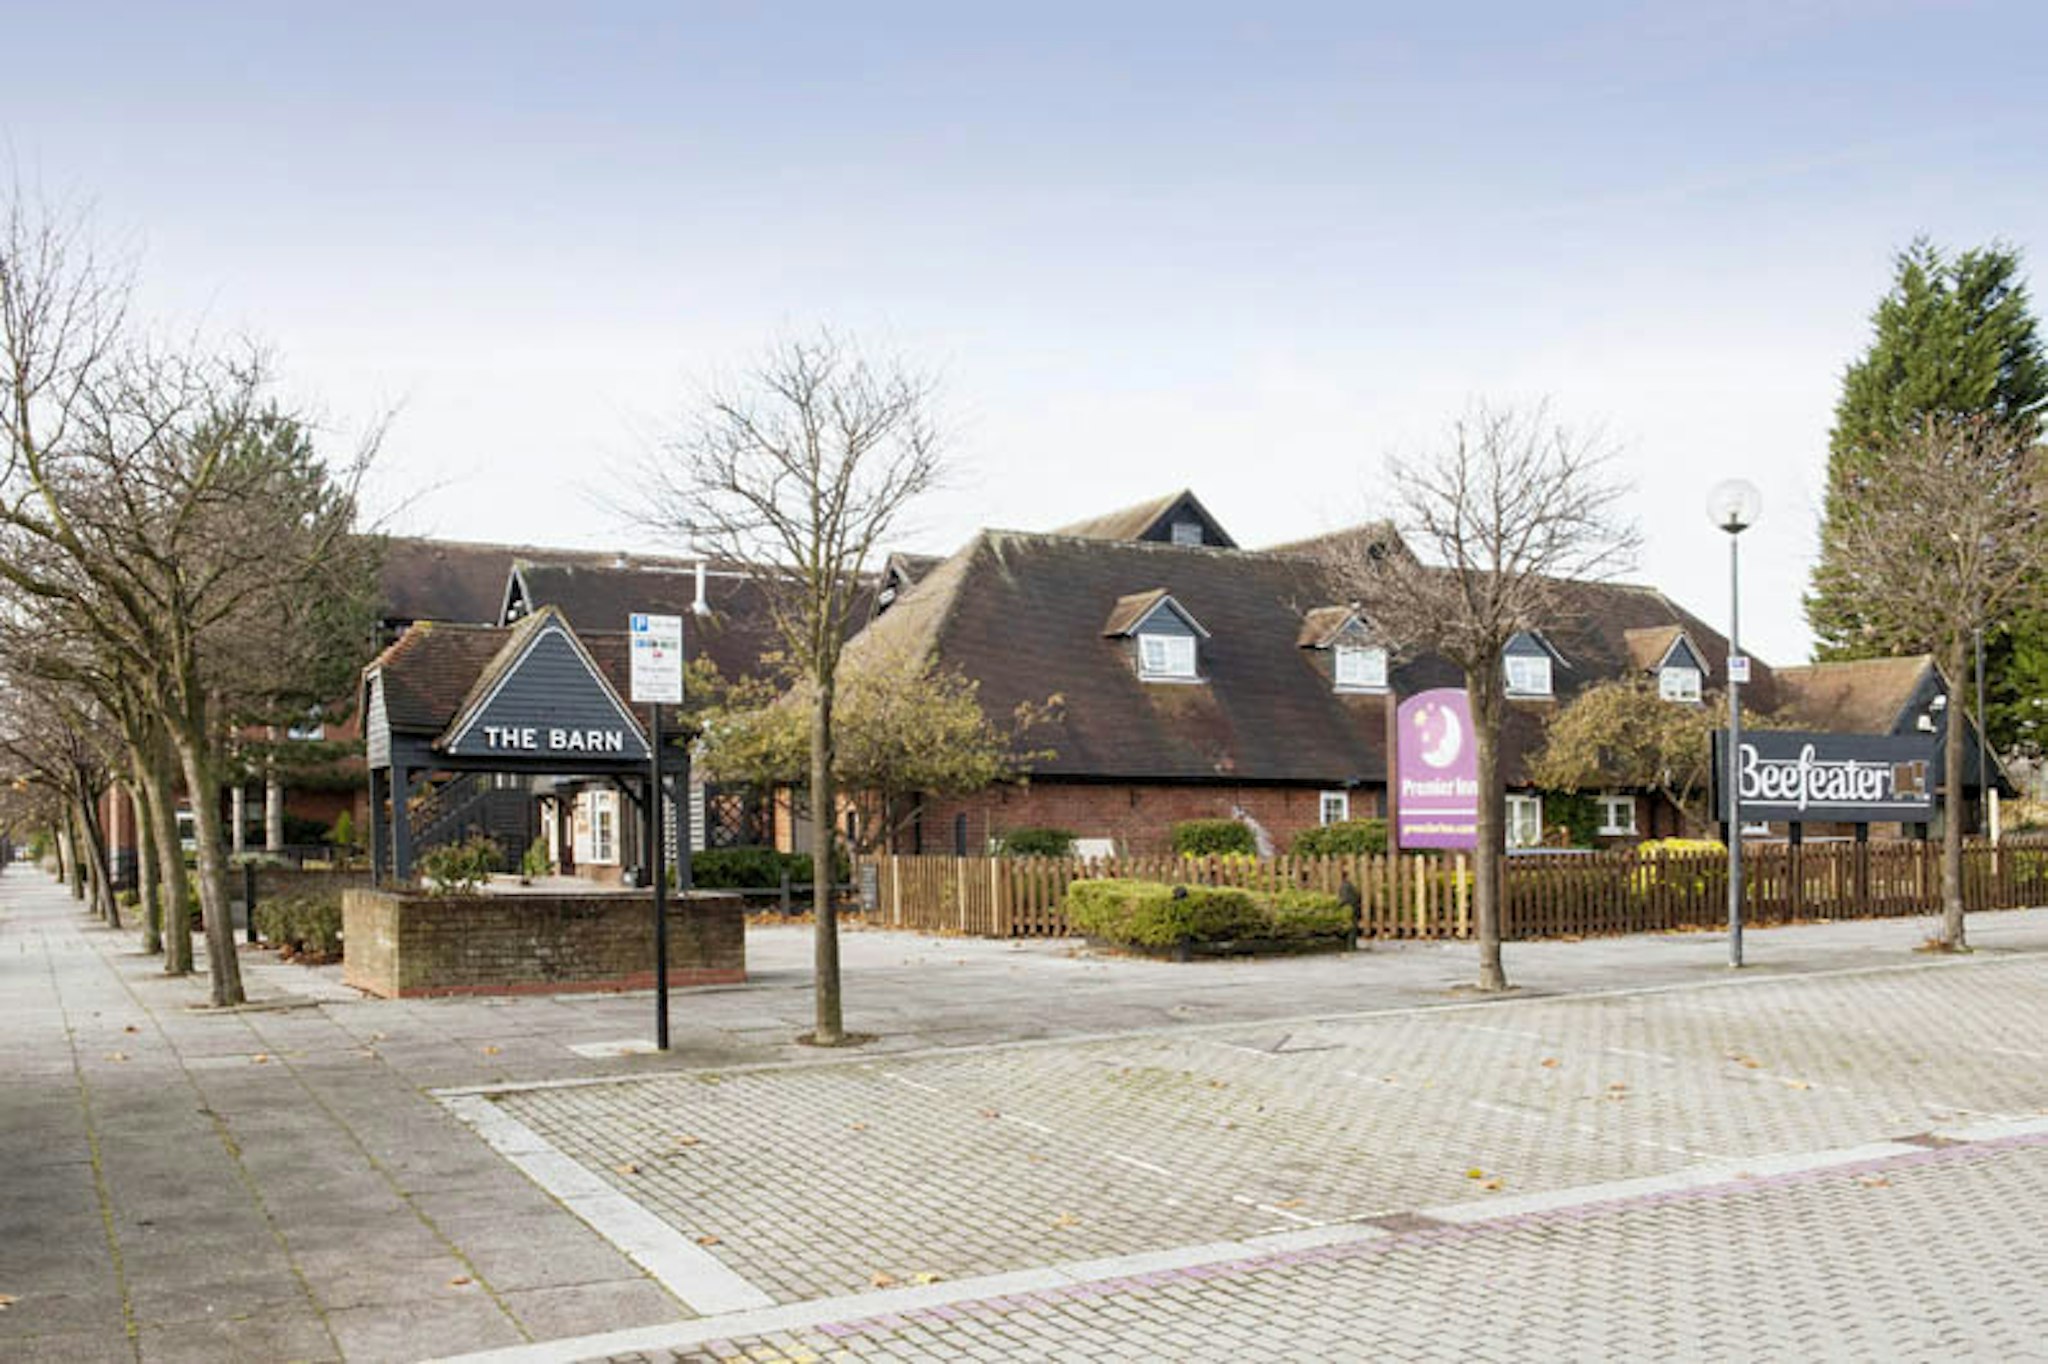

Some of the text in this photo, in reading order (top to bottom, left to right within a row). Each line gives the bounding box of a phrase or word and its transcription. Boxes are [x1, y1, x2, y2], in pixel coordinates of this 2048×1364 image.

[484, 726, 624, 751] THE BARN
[1402, 777, 1455, 797] Premier
[1738, 743, 1890, 812] Beefeater
